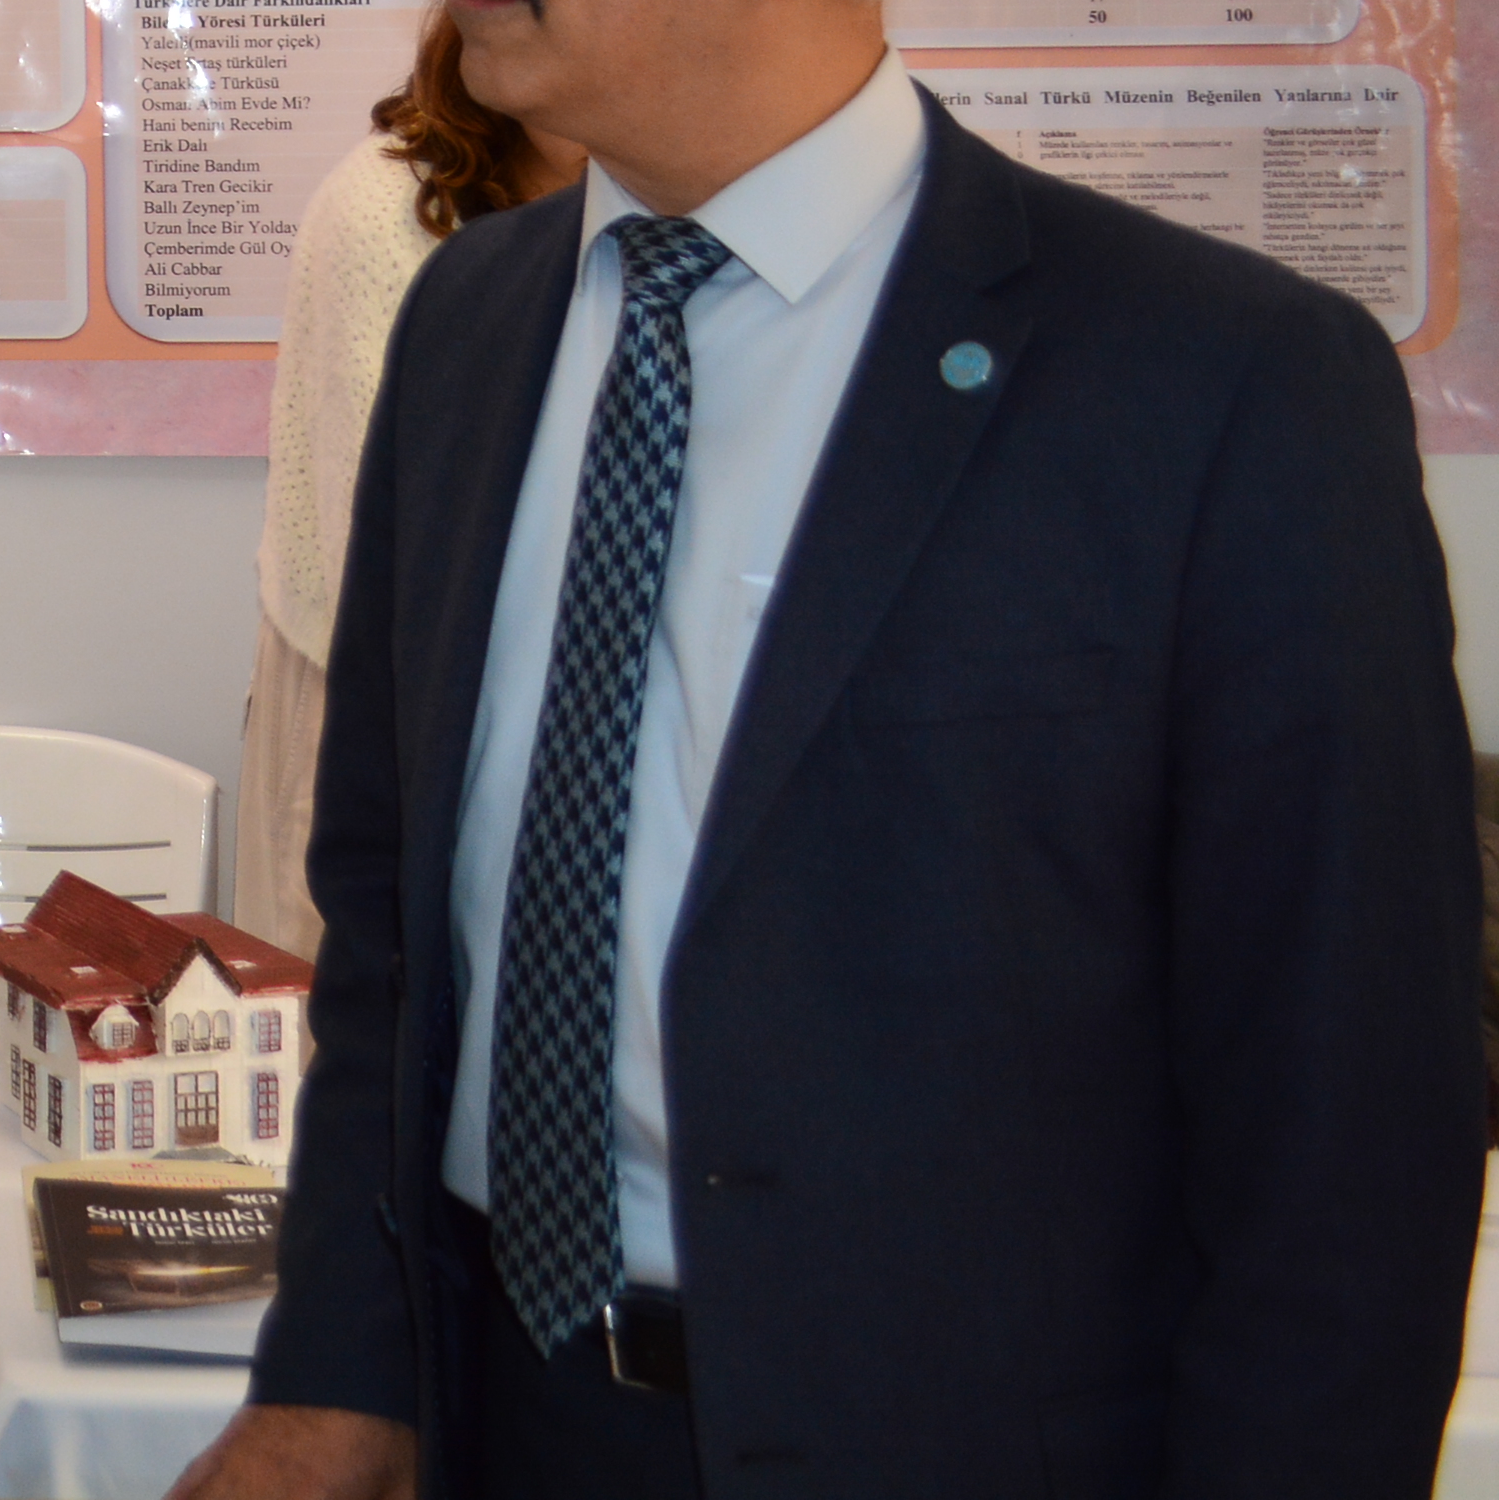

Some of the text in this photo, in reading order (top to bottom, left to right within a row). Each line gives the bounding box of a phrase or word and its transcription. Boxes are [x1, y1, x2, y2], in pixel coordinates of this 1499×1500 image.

[1089, 9, 1253, 23] 50 100
[144, 180, 273, 193] Kara Tren Gecikir
[145, 263, 222, 275] Ali Cabbar
[127, 1220, 273, 1238] Türküler
